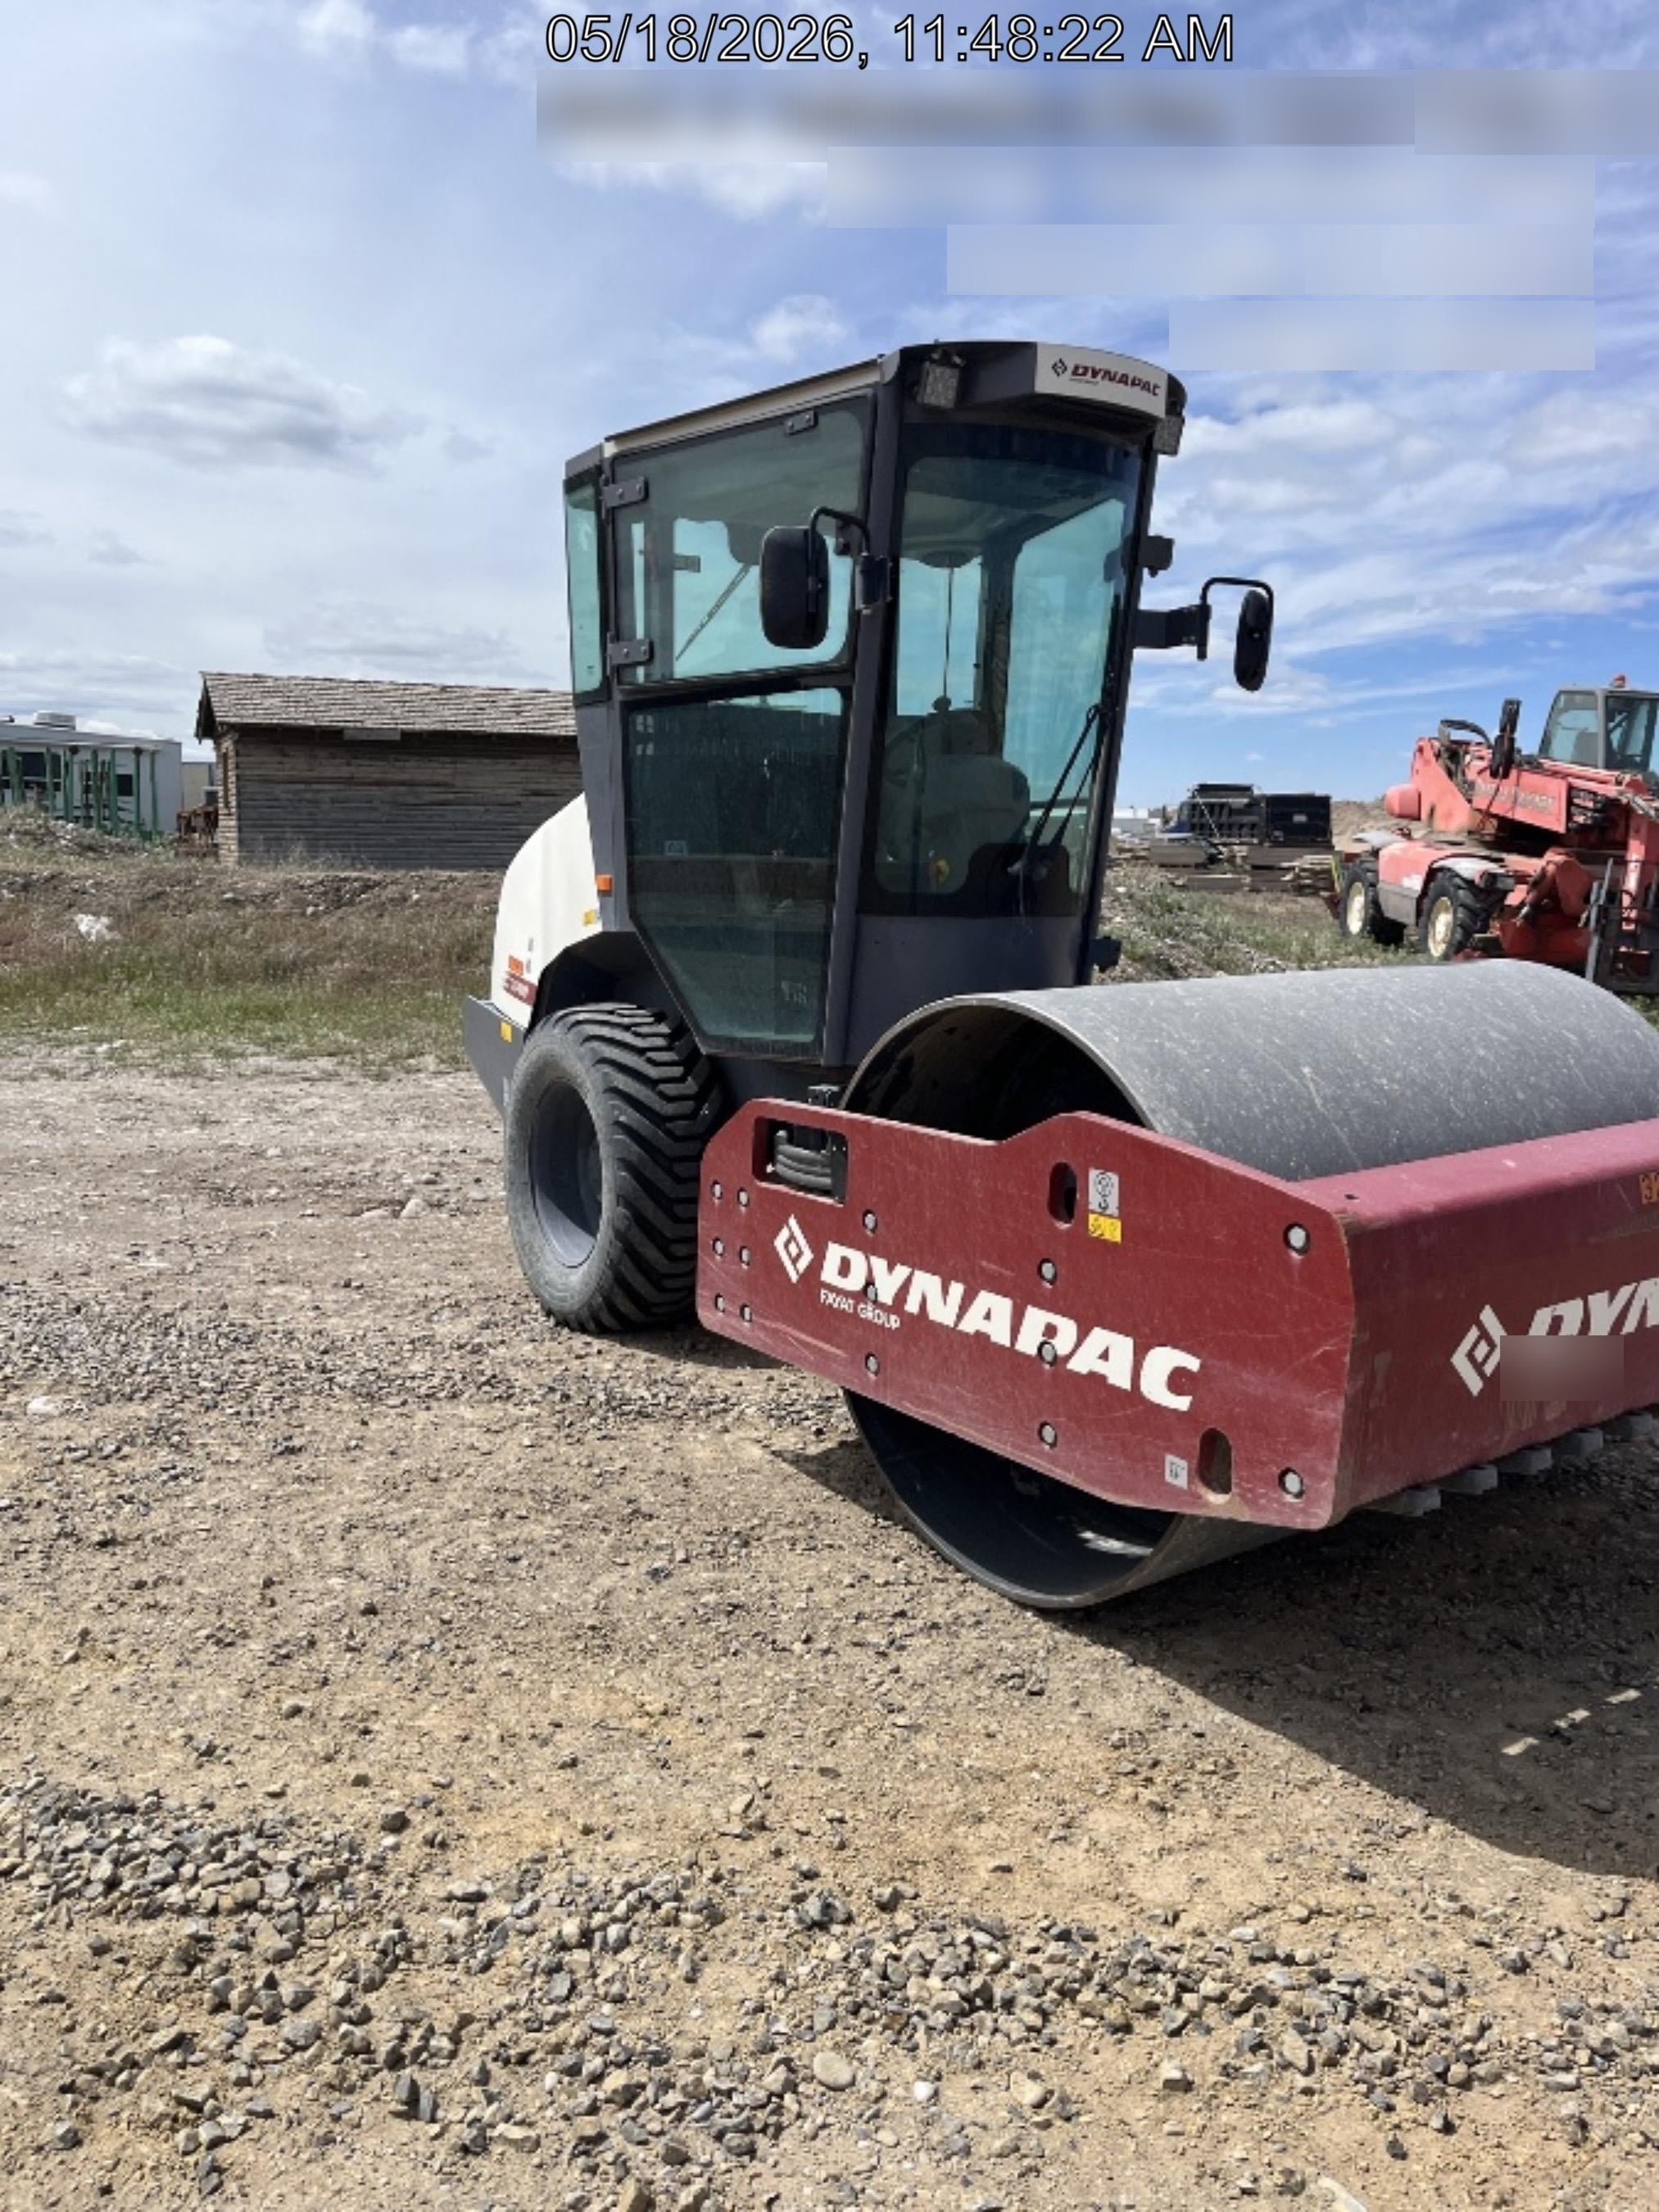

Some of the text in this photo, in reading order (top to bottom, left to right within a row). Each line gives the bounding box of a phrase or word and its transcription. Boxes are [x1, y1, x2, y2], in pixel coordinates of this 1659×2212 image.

[1071, 363, 1161, 397] DYNAPAC
[820, 1240, 1202, 1412] DYNAPAC
[857, 1302, 900, 1330] GROUP
